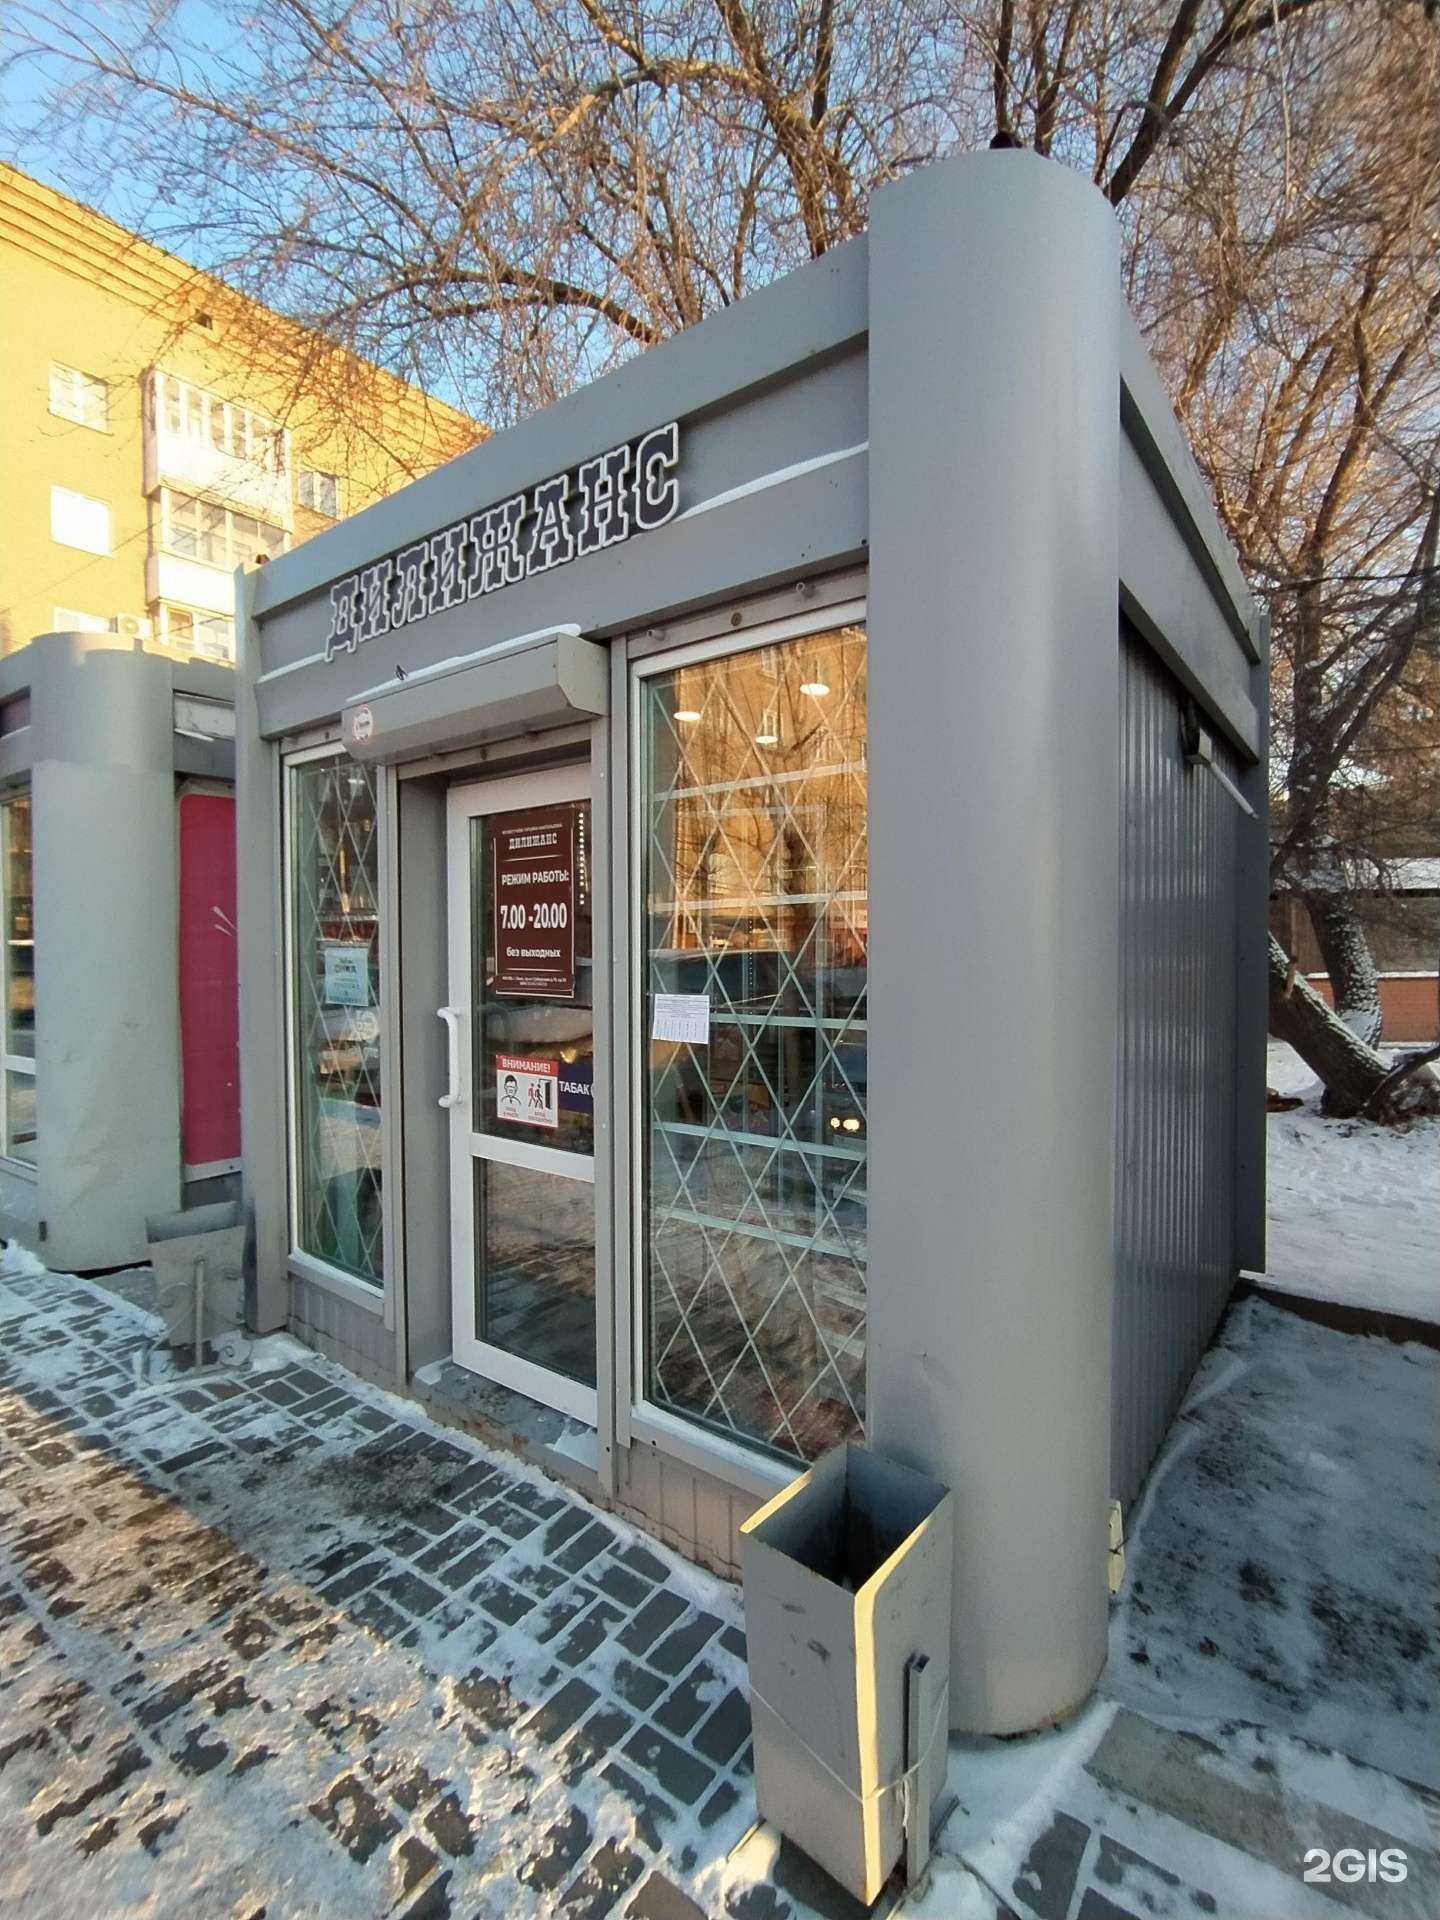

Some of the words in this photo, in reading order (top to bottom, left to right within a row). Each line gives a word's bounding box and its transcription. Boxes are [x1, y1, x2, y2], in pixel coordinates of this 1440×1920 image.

[324, 422, 680, 662] ДИЛИЖАНС
[509, 833, 557, 849] ДИЛИЖАНС
[502, 873, 530, 885] РЕЖИМ
[533, 870, 569, 883] РАБОТЫ:
[500, 904, 526, 930] 7.00
[506, 946, 520, 958] без
[521, 947, 561, 958] выходных
[502, 1058, 550, 1073] ВНИМАНИЕ!
[559, 1081, 590, 1095] ТАБАК
